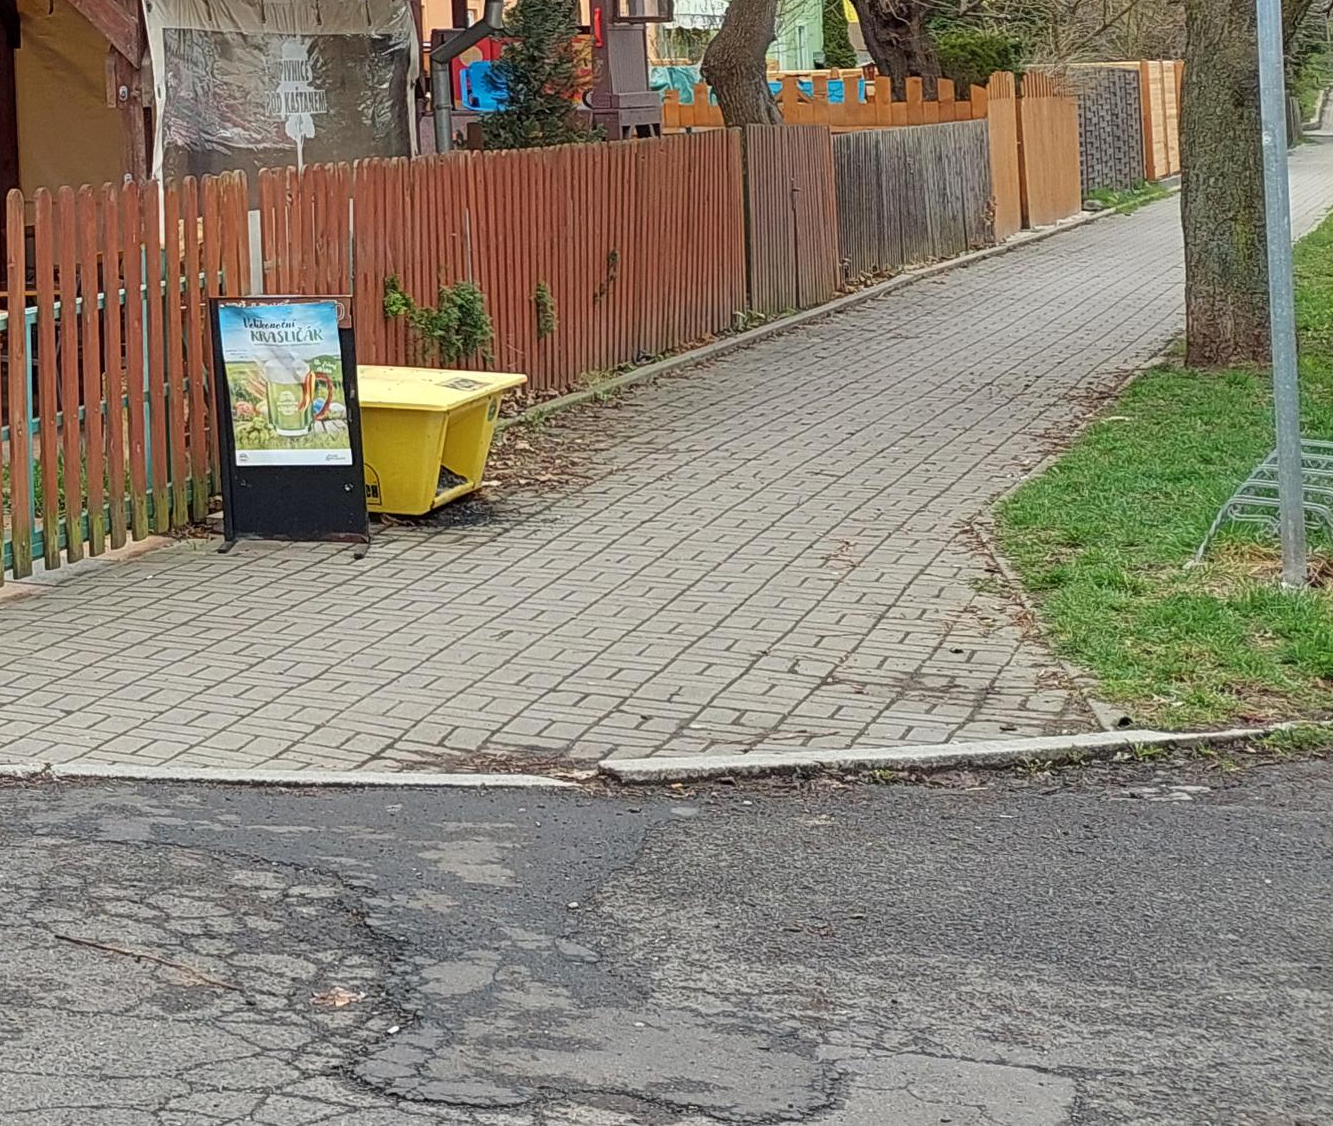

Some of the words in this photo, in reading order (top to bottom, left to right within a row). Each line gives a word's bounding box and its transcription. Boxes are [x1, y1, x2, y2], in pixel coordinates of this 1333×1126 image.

[277, 60, 309, 82] PIVNICE
[243, 317, 296, 329] Velikonoční
[250, 326, 324, 344] KRASLIČÁK
